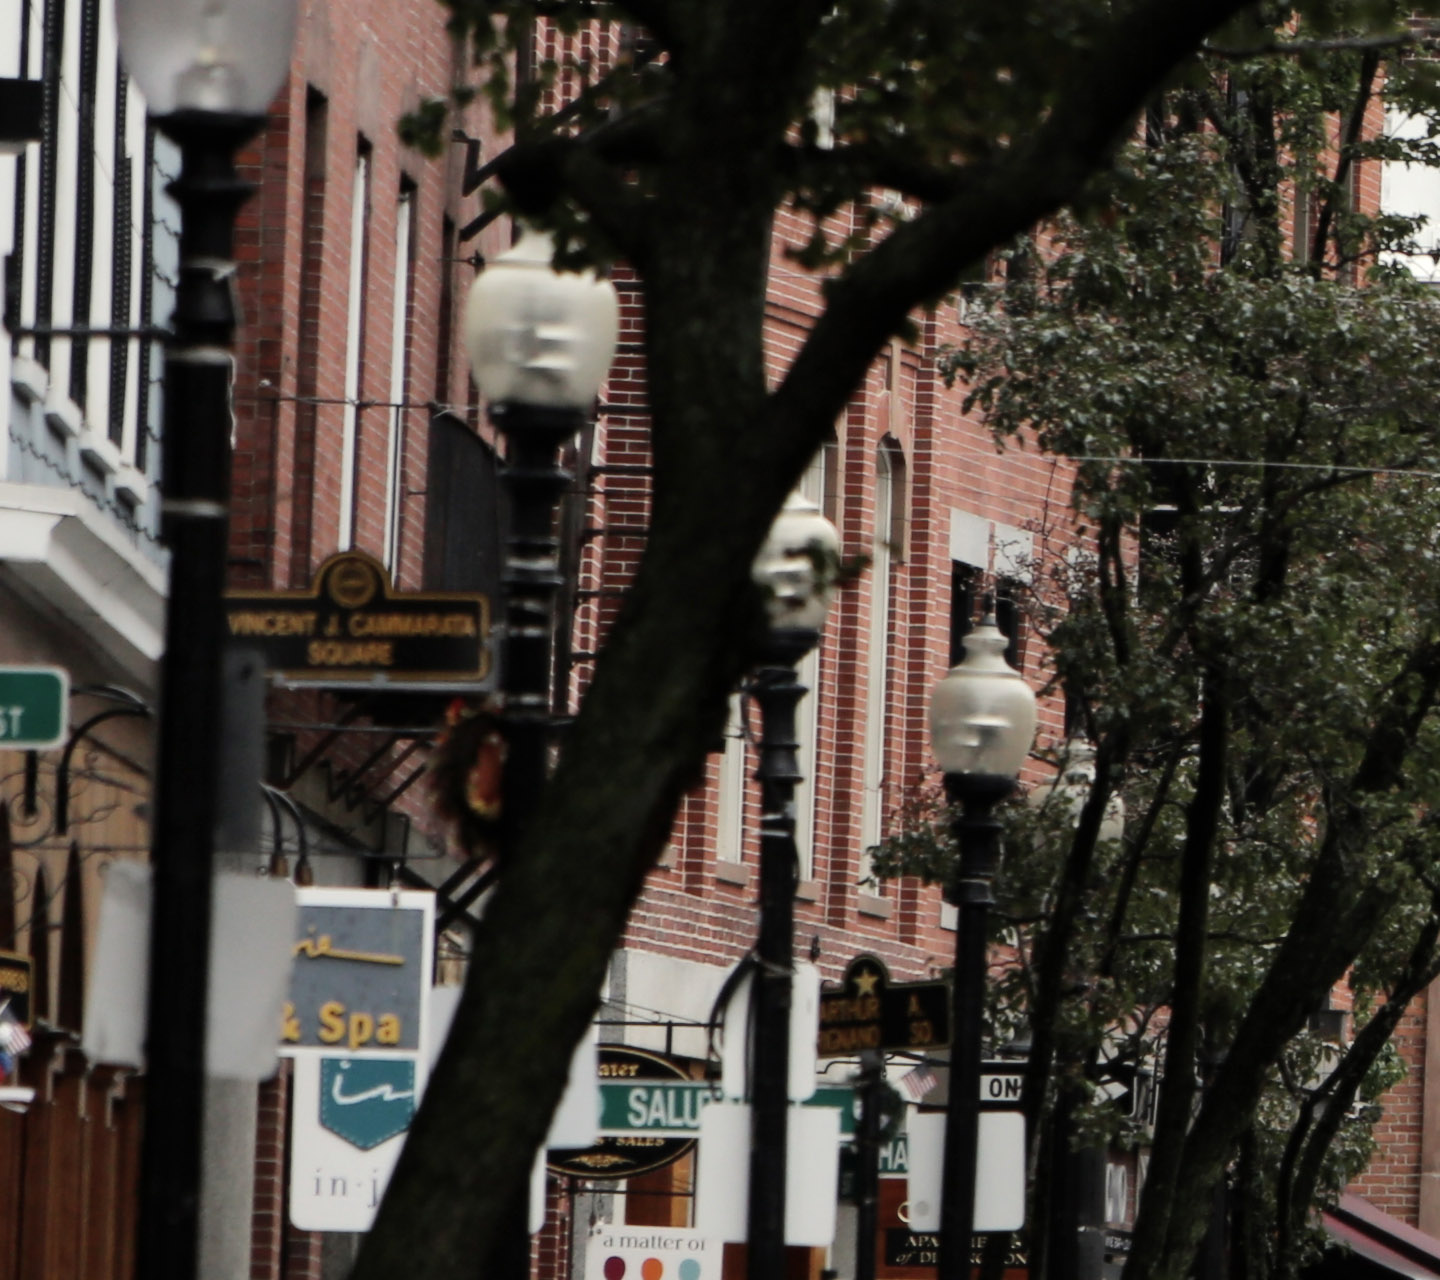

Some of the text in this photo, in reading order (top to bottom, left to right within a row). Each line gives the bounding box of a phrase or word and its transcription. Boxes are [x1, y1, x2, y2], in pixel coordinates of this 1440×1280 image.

[227, 610, 317, 636] VINCENT
[308, 639, 393, 666] SQUARE
[318, 1001, 401, 1049] Spa
[603, 1236, 613, 1248] a
[619, 1235, 684, 1251] matter
